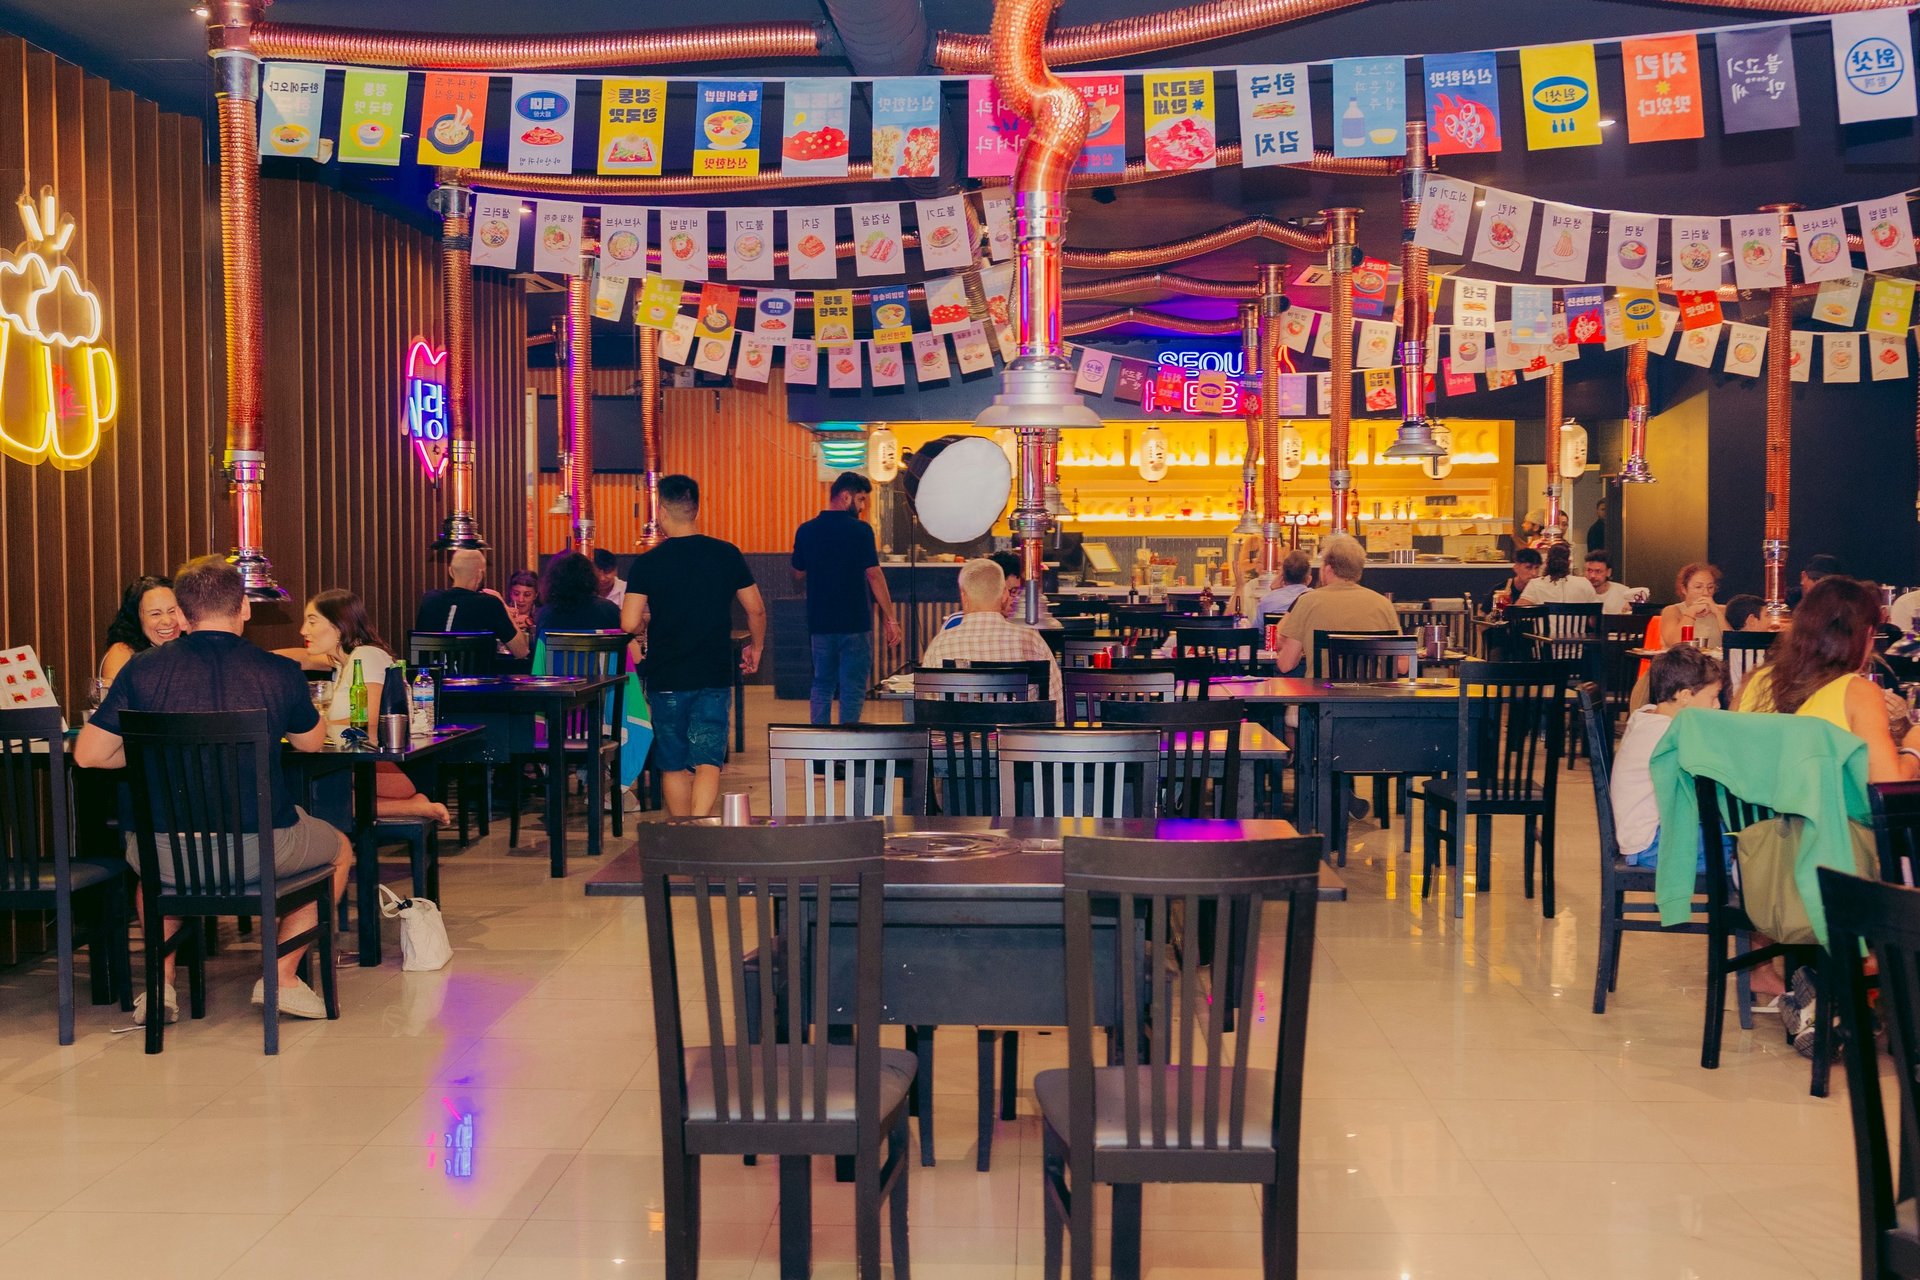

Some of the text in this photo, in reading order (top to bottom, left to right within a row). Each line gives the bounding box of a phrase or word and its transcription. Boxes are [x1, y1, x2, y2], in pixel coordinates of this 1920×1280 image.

[1462, 285, 1488, 301] 한국
[1685, 302, 1715, 318] 맛있다
[1462, 315, 1488, 328] 김치
[1157, 352, 1264, 377] SEOU
